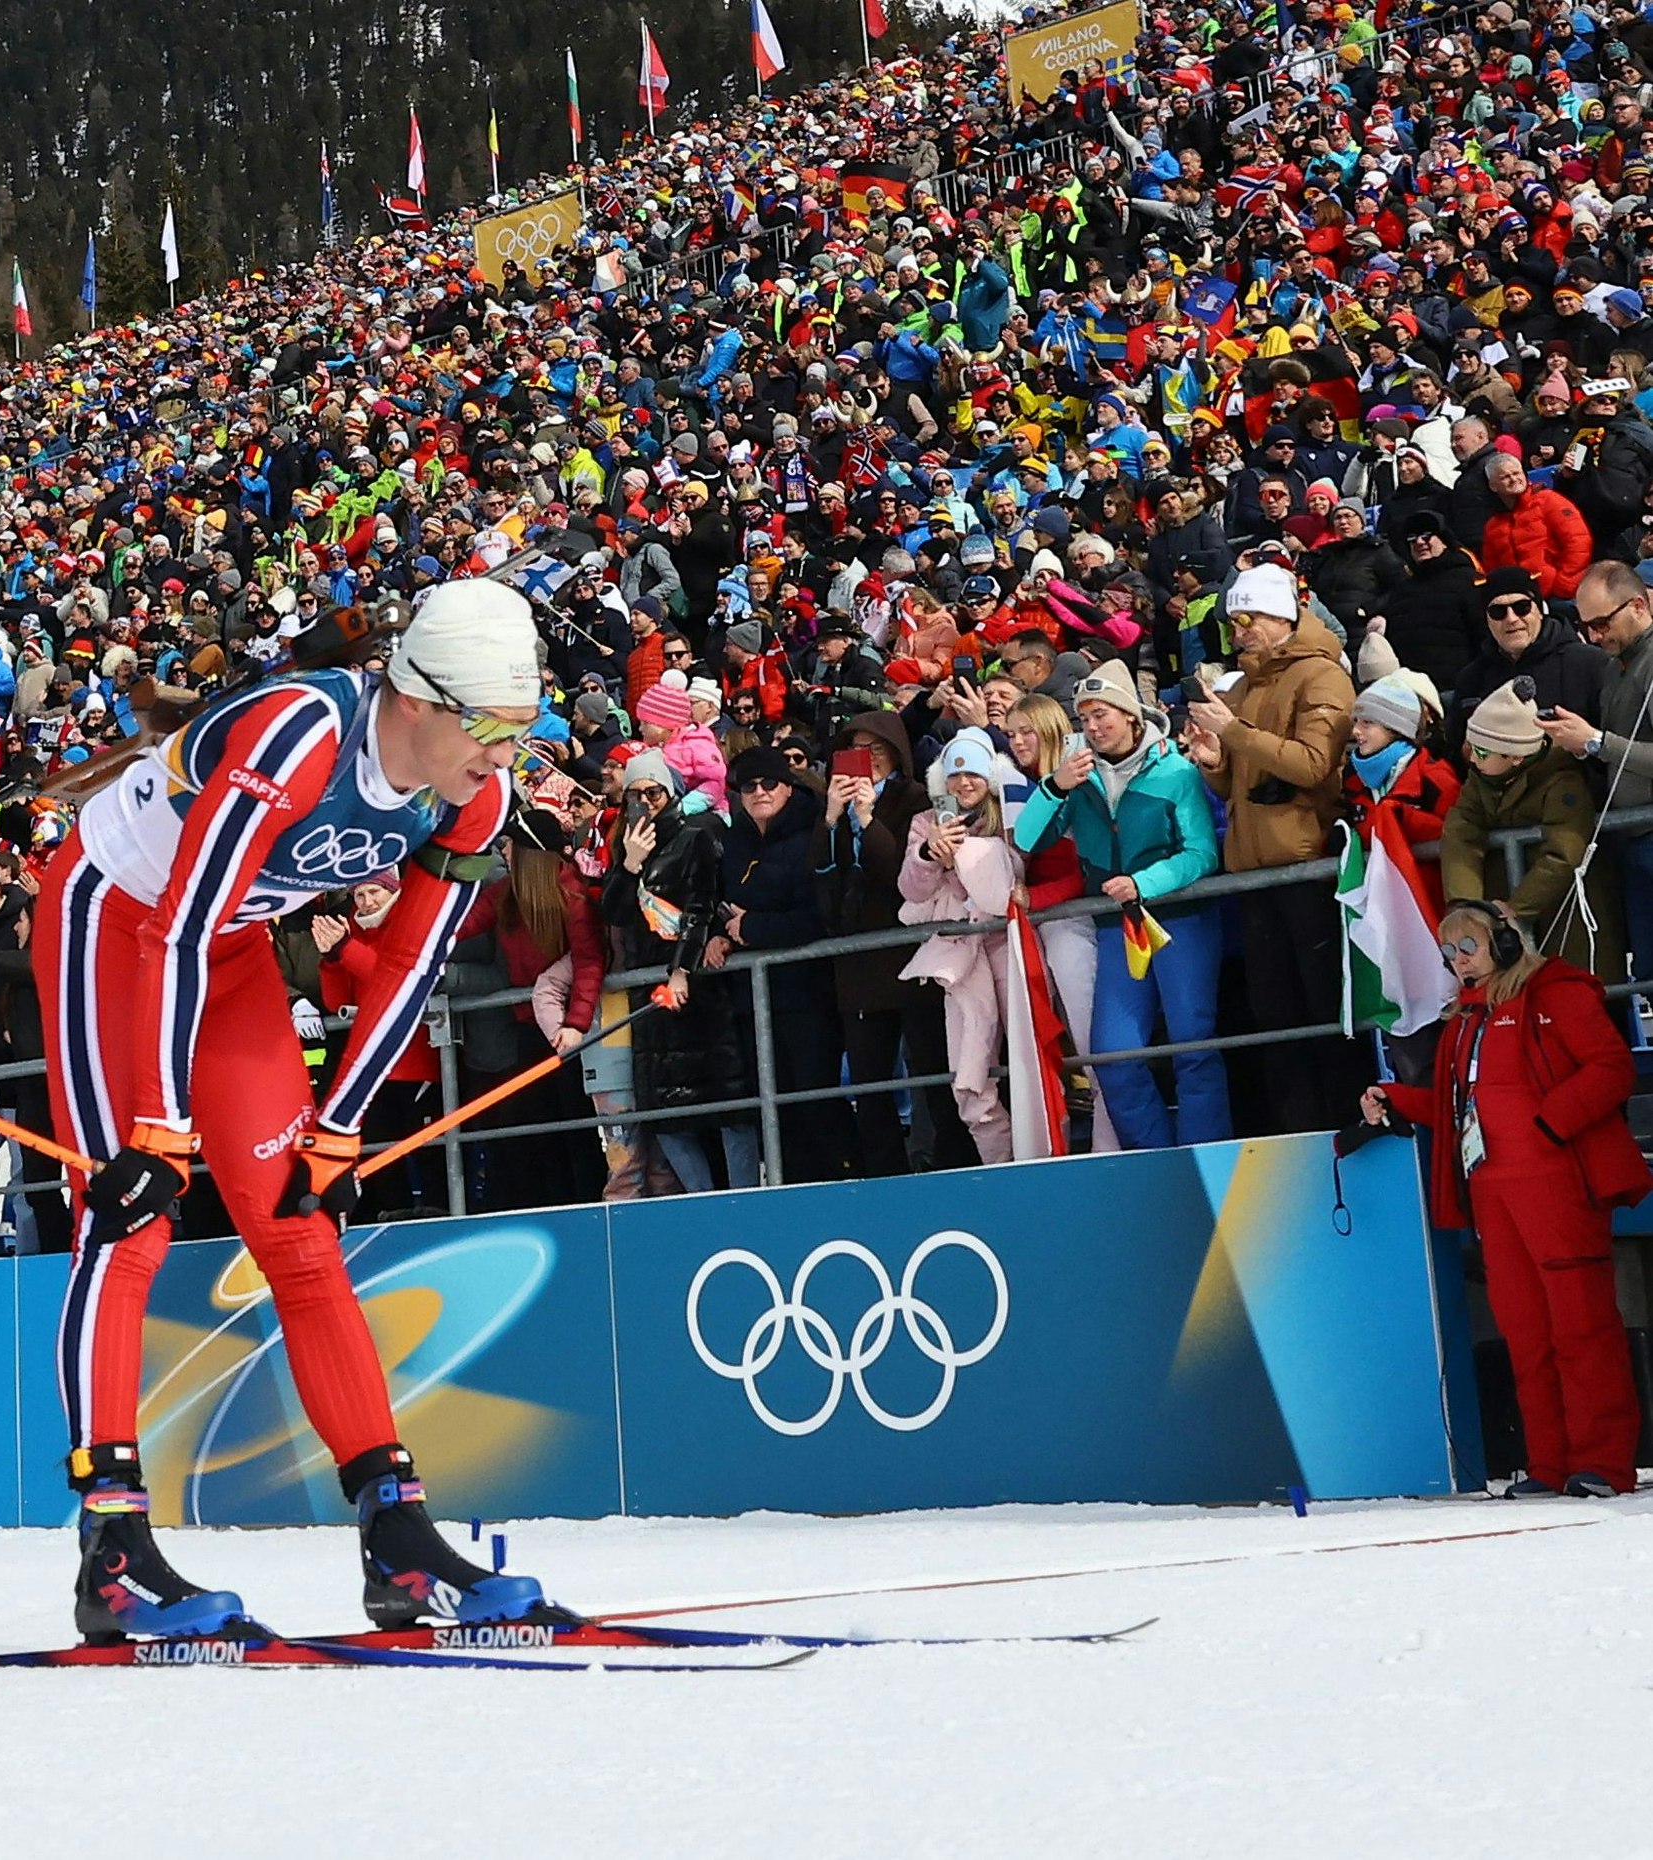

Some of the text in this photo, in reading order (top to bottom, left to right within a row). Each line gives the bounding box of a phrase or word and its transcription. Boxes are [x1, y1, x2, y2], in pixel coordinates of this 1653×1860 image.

[1031, 23, 1101, 58] MILANO
[1044, 38, 1119, 71] CORTINA
[134, 777, 154, 811] 2
[228, 768, 281, 801] CRAFT
[233, 895, 286, 924] 2
[253, 1114, 304, 1160] CRAFT
[133, 1640, 245, 1664] SALOMON
[433, 1625, 553, 1648] SALOMON
